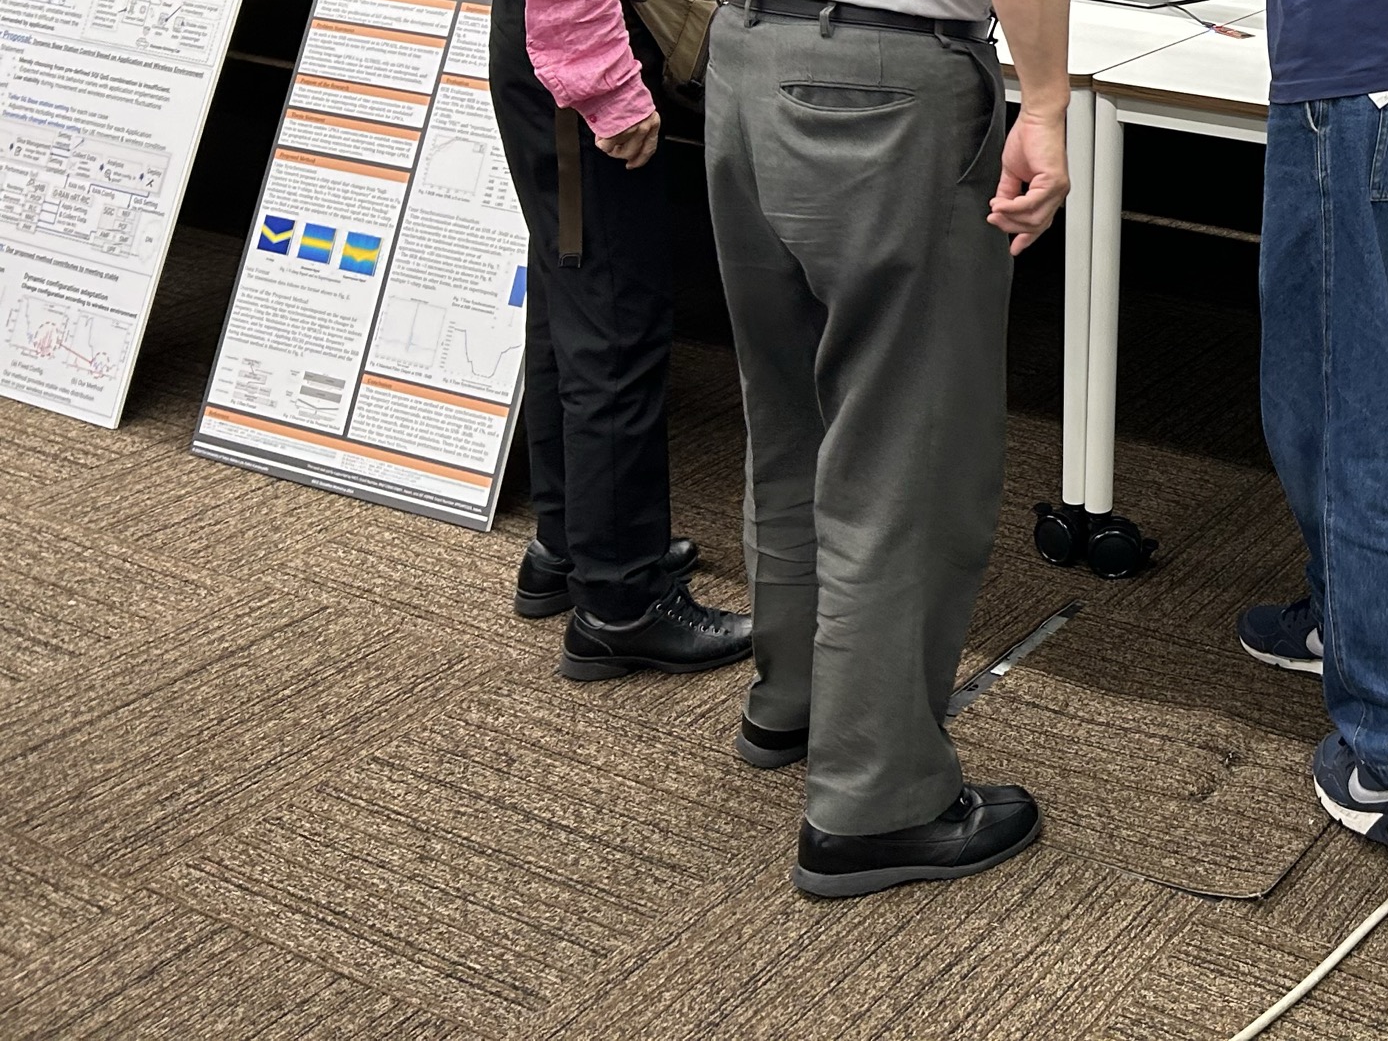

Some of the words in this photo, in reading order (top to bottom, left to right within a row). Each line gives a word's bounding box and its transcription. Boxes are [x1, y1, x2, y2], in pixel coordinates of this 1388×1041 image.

[23, 272, 45, 285] Dynamic
[45, 278, 80, 294] configuration
[80, 287, 108, 302] adaptation
